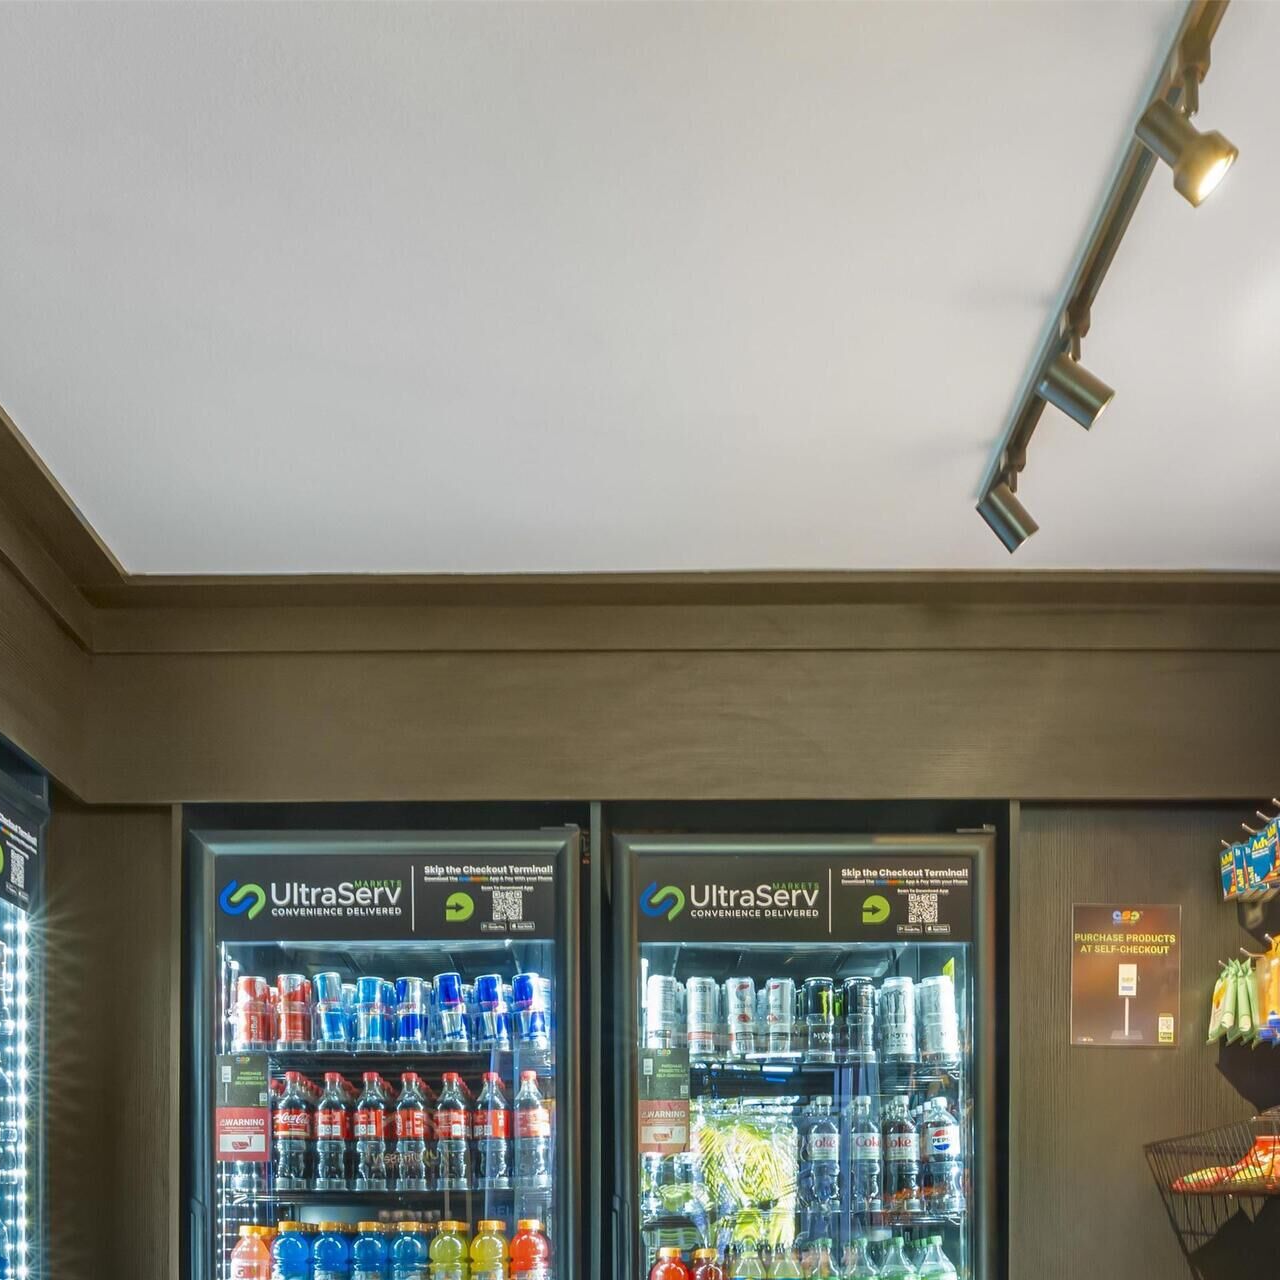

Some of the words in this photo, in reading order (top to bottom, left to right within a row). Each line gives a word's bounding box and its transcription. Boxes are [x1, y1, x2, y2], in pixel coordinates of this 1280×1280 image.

[424, 865, 445, 876] Skip
[446, 865, 462, 875] the
[463, 865, 508, 875] Checkout
[509, 865, 553, 874] Terminal!
[841, 868, 861, 878] Skip
[862, 868, 878, 876] the
[879, 868, 923, 877] Checkout
[924, 868, 968, 877] Terminal!
[354, 879, 403, 889] MARKETS
[772, 881, 820, 889] MARKETS
[271, 882, 402, 906] UltraServ
[690, 884, 819, 907] UltraServ
[271, 907, 344, 917] CONVENIENCE
[346, 907, 402, 917] DELIVERED
[690, 909, 761, 918] CONVENIENCE
[764, 909, 819, 918] DELIVERED
[1074, 933, 1124, 943] PURCHASE
[1126, 933, 1177, 944] PRODUCTS
[1080, 944, 1093, 954] AT
[1094, 944, 1170, 955] SELF-CHECKOUT
[647, 1110, 686, 1119] WARNING
[224, 1118, 265, 1127] WARNING
